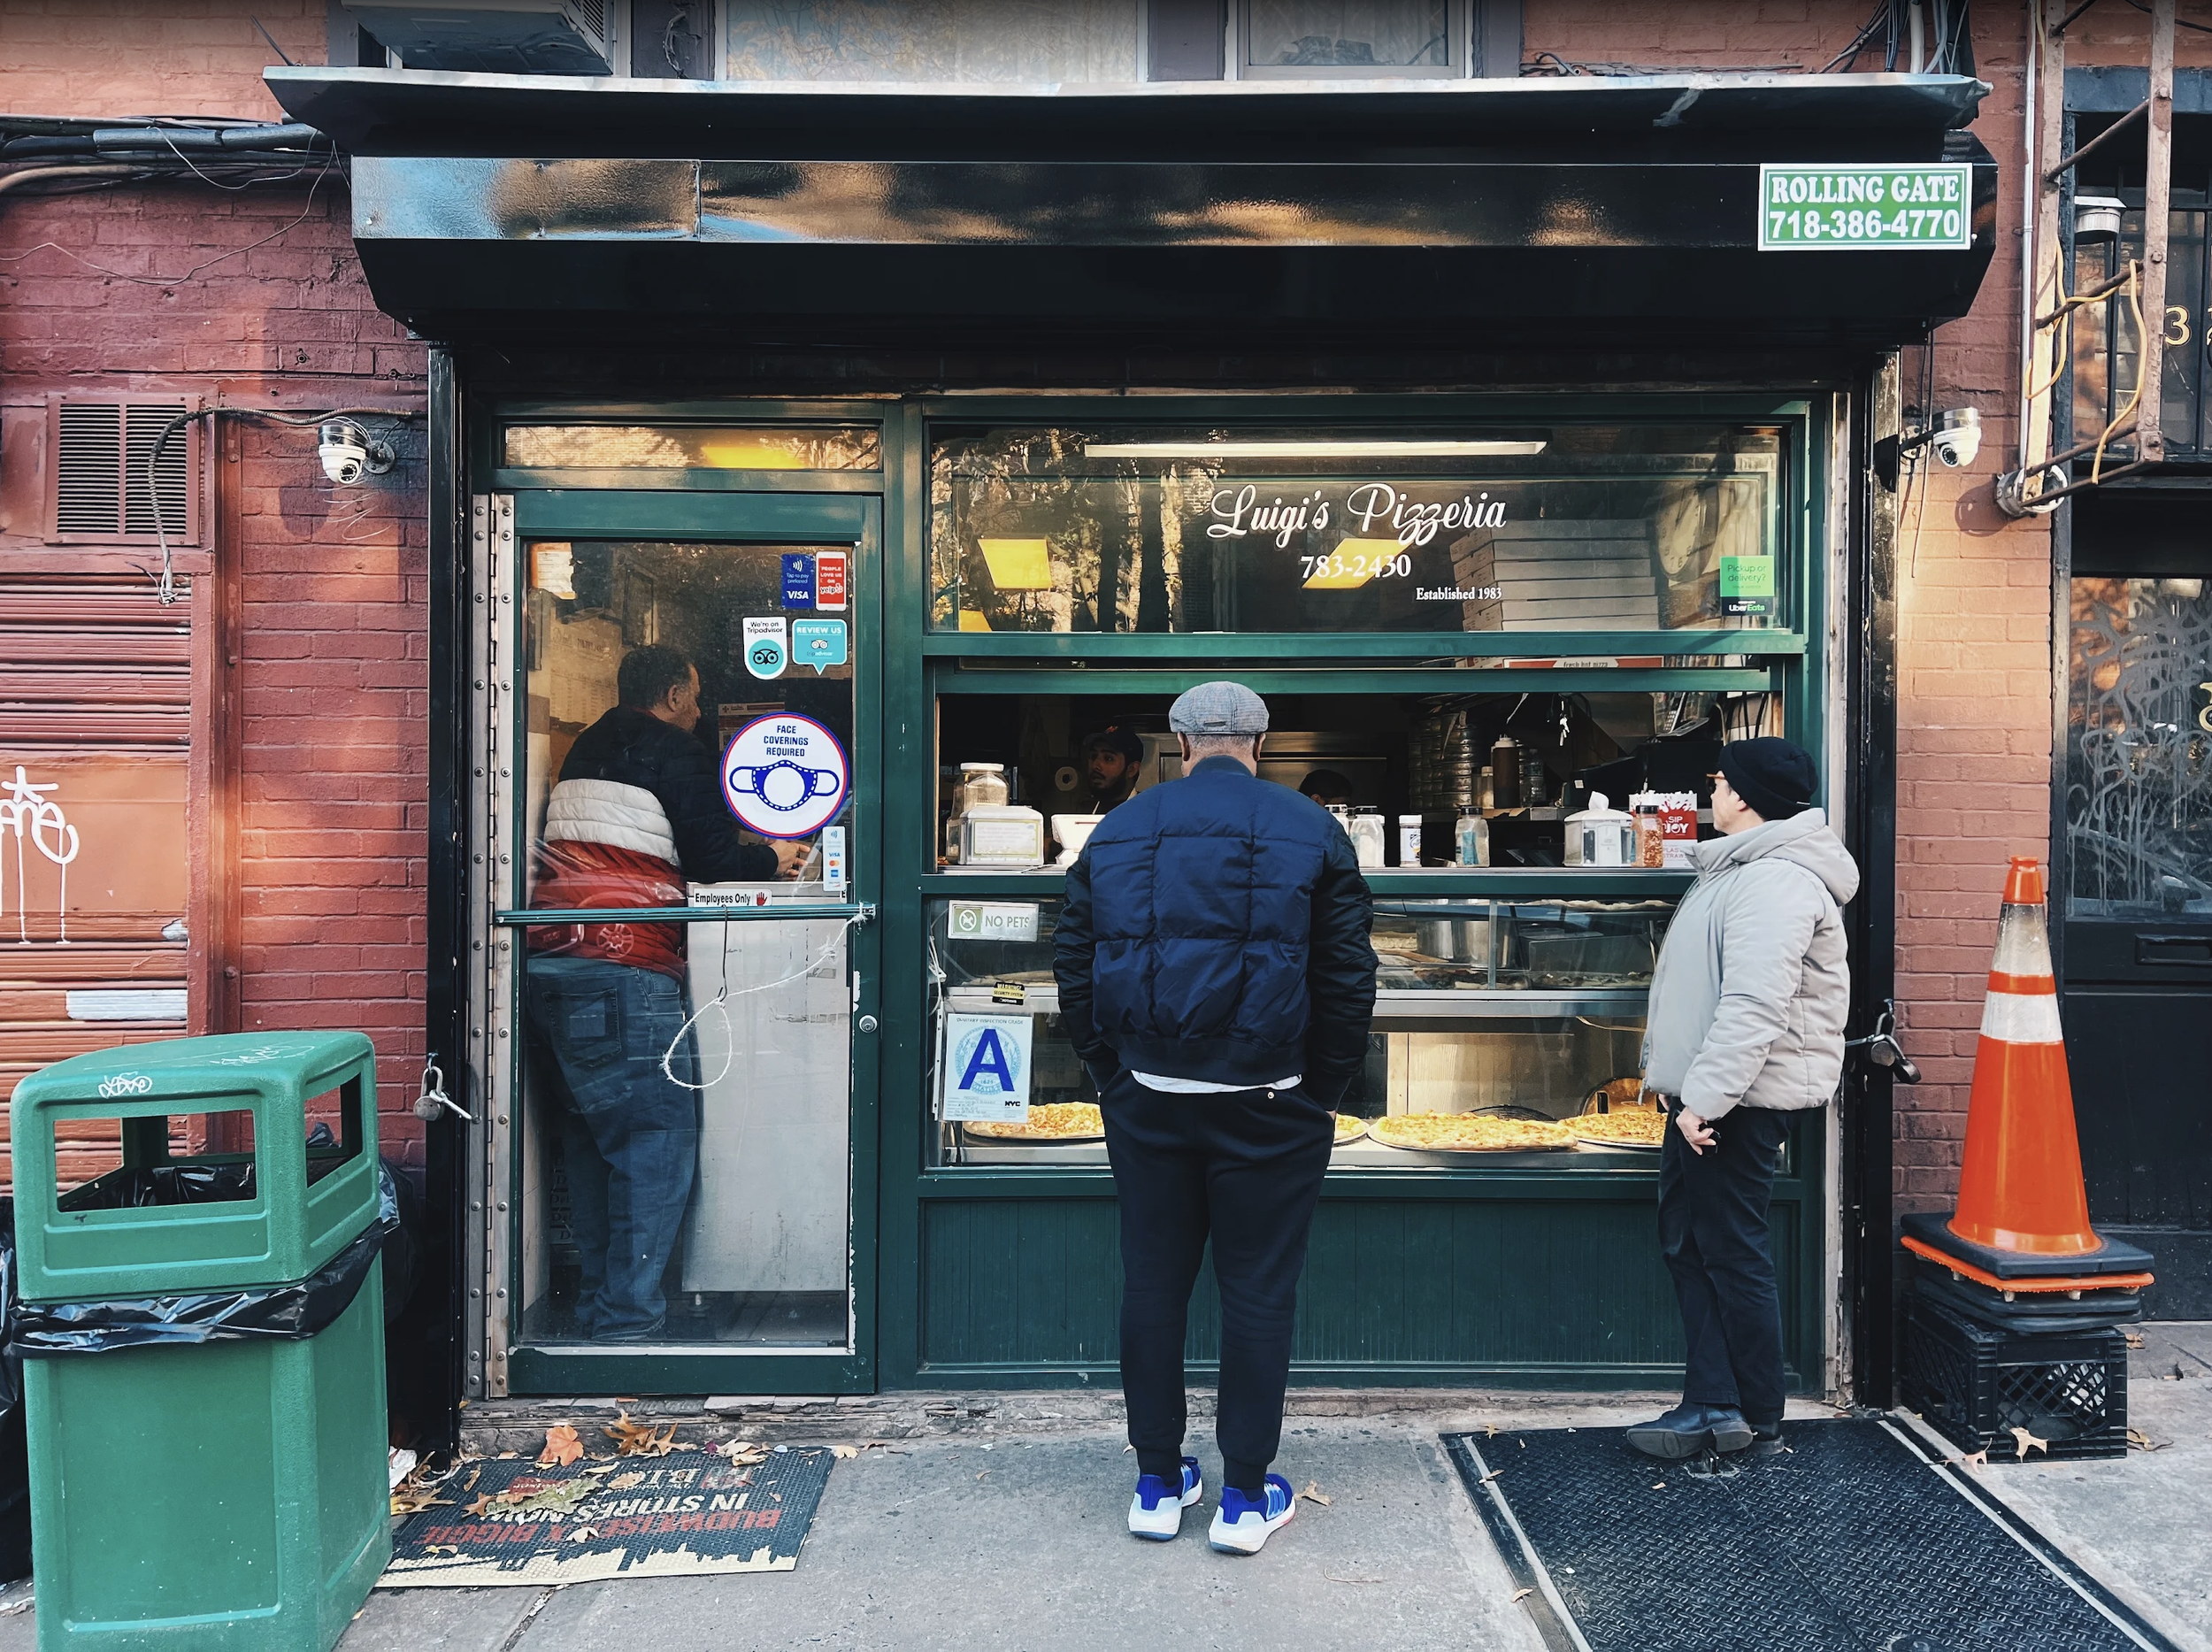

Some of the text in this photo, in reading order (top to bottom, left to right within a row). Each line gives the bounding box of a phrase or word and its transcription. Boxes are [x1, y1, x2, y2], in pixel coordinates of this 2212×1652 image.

[1771, 174, 1960, 204] ROLLING GATE
[1770, 210, 1961, 239] 718-386-4770
[1206, 482, 1507, 549] Luigi's Pizzeria
[1301, 554, 1411, 579] 783-2430
[1727, 564, 1755, 572] Pickup
[1727, 573, 1766, 583] delivery?
[787, 590, 809, 600] VISA
[820, 586, 835, 595] yelp
[1416, 587, 1502, 601] Established 1983
[777, 725, 796, 734] FACE
[764, 735, 809, 746] COVERINGS
[766, 747, 805, 757] REQUIRED
[695, 893, 751, 904] Employees Only
[985, 915, 1030, 928] NO PETS
[958, 1028, 1015, 1091] A
[572, 1494, 704, 1523] STORES
[710, 1493, 749, 1511] IN
[412, 1523, 540, 1545] BIGGIE
